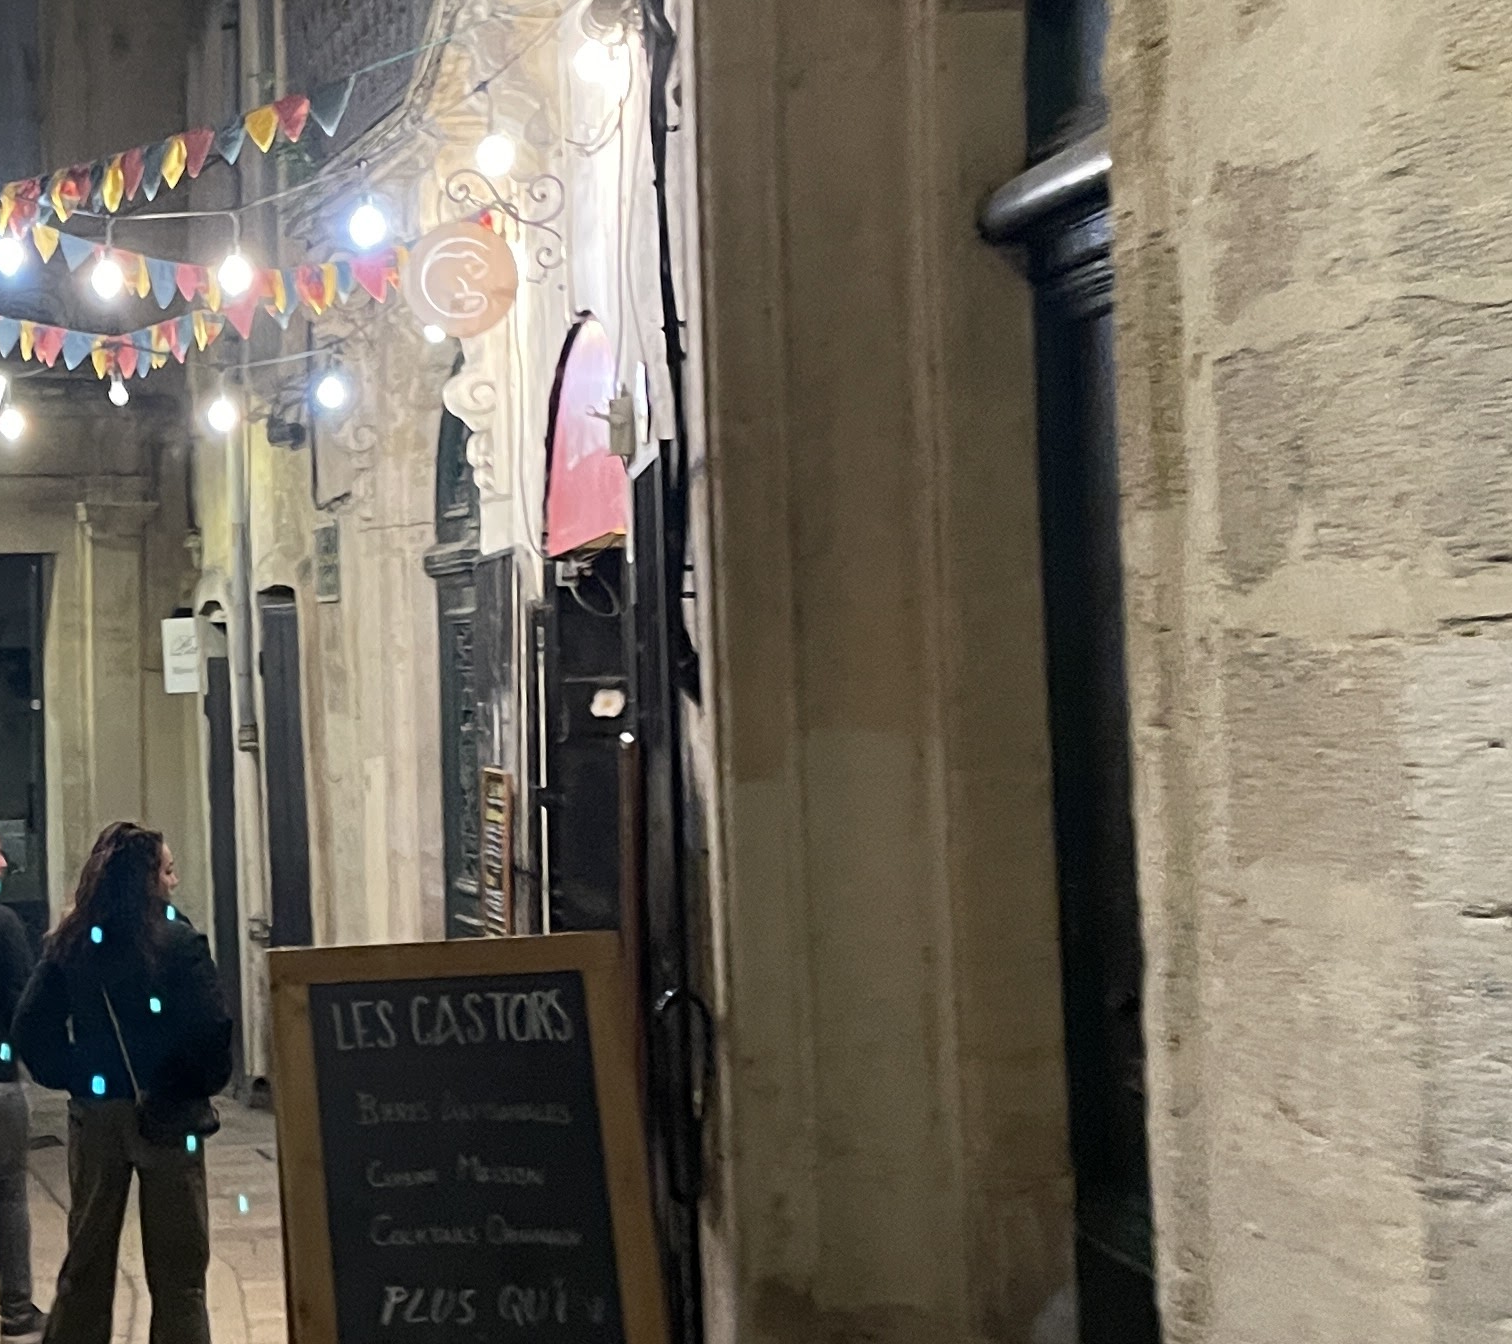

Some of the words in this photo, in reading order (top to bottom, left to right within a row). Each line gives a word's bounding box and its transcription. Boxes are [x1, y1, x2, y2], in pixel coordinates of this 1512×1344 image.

[331, 999, 397, 1051] LES
[410, 989, 575, 1046] CASTORS
[380, 1286, 477, 1326] PLUS
